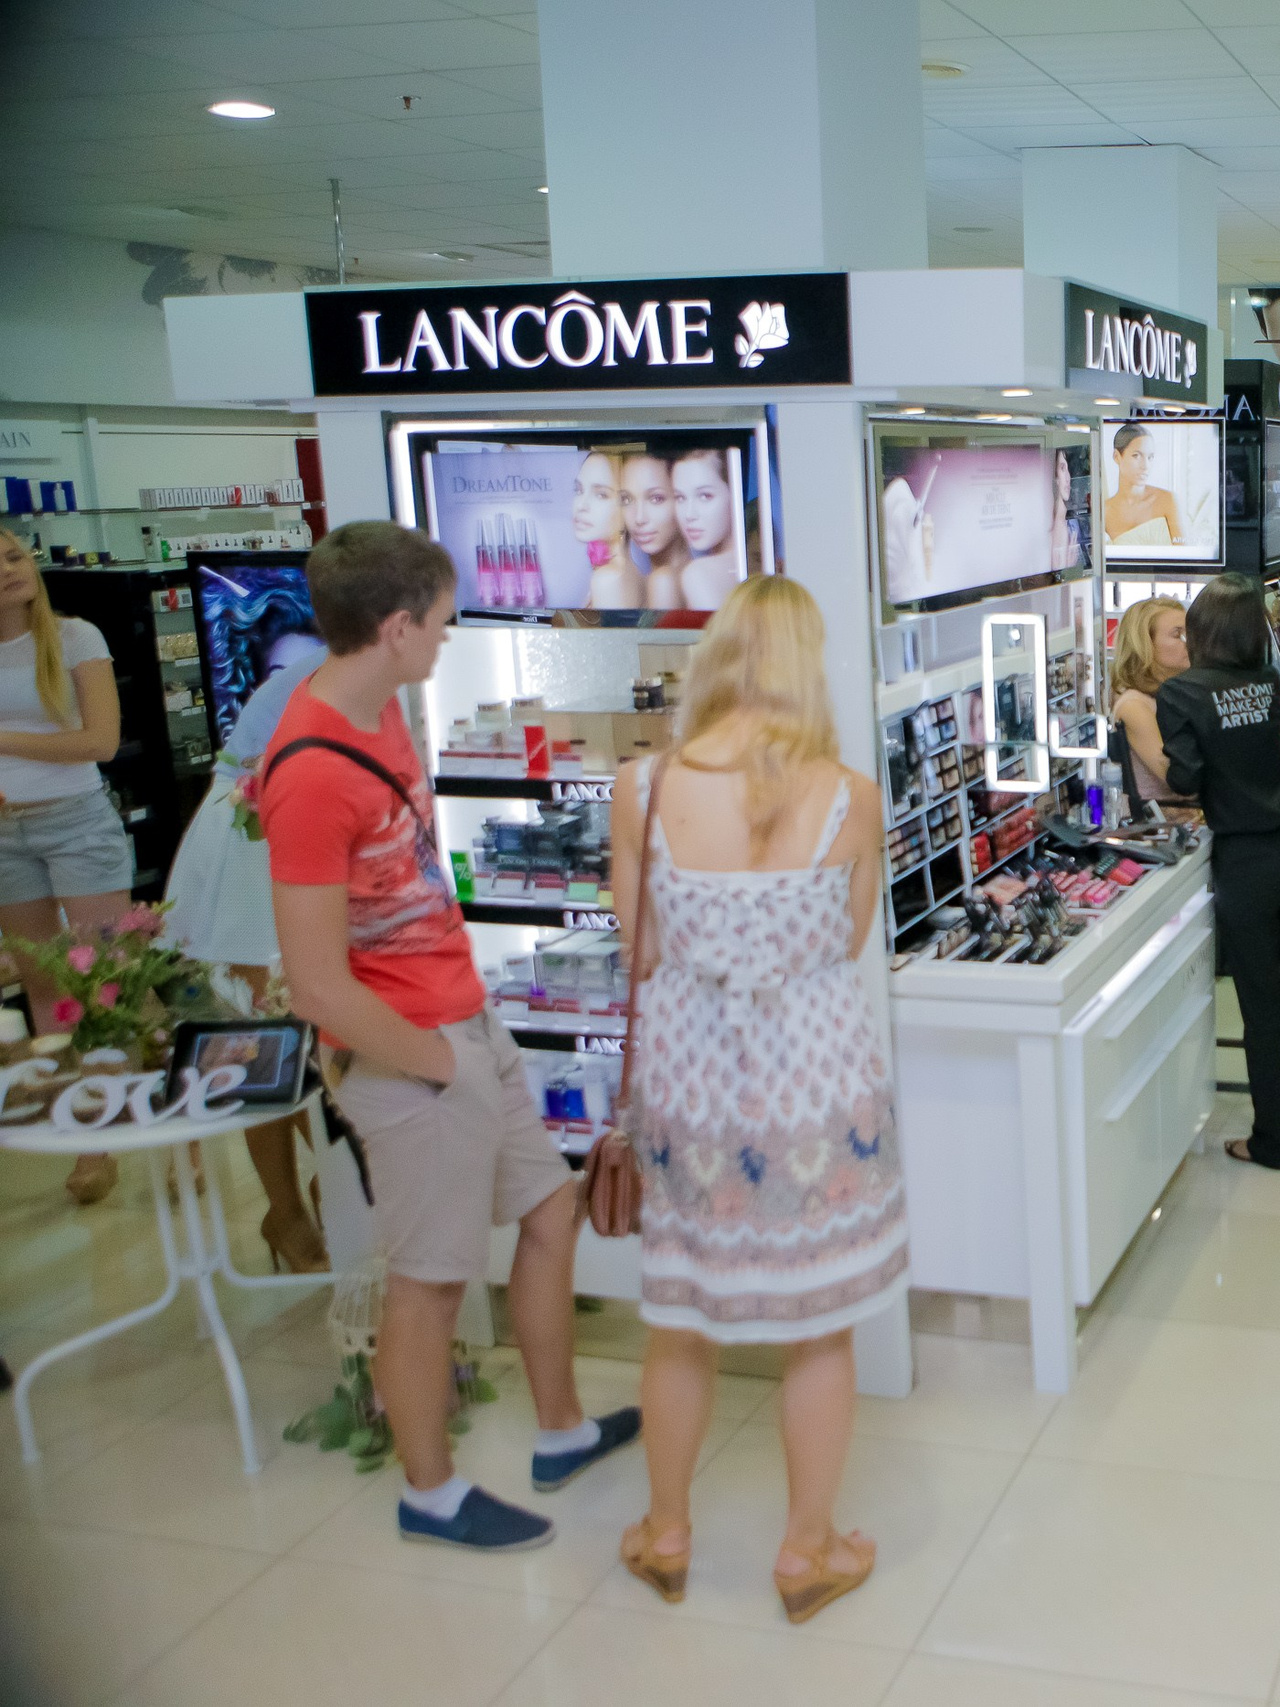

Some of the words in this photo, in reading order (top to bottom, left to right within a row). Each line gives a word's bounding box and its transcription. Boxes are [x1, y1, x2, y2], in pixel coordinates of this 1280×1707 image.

[359, 290, 714, 373] LANCÔME
[1085, 309, 1182, 384] LANCÔME
[1216, 696, 1273, 717] MAKE-UP
[1221, 709, 1269, 729] ARTIST
